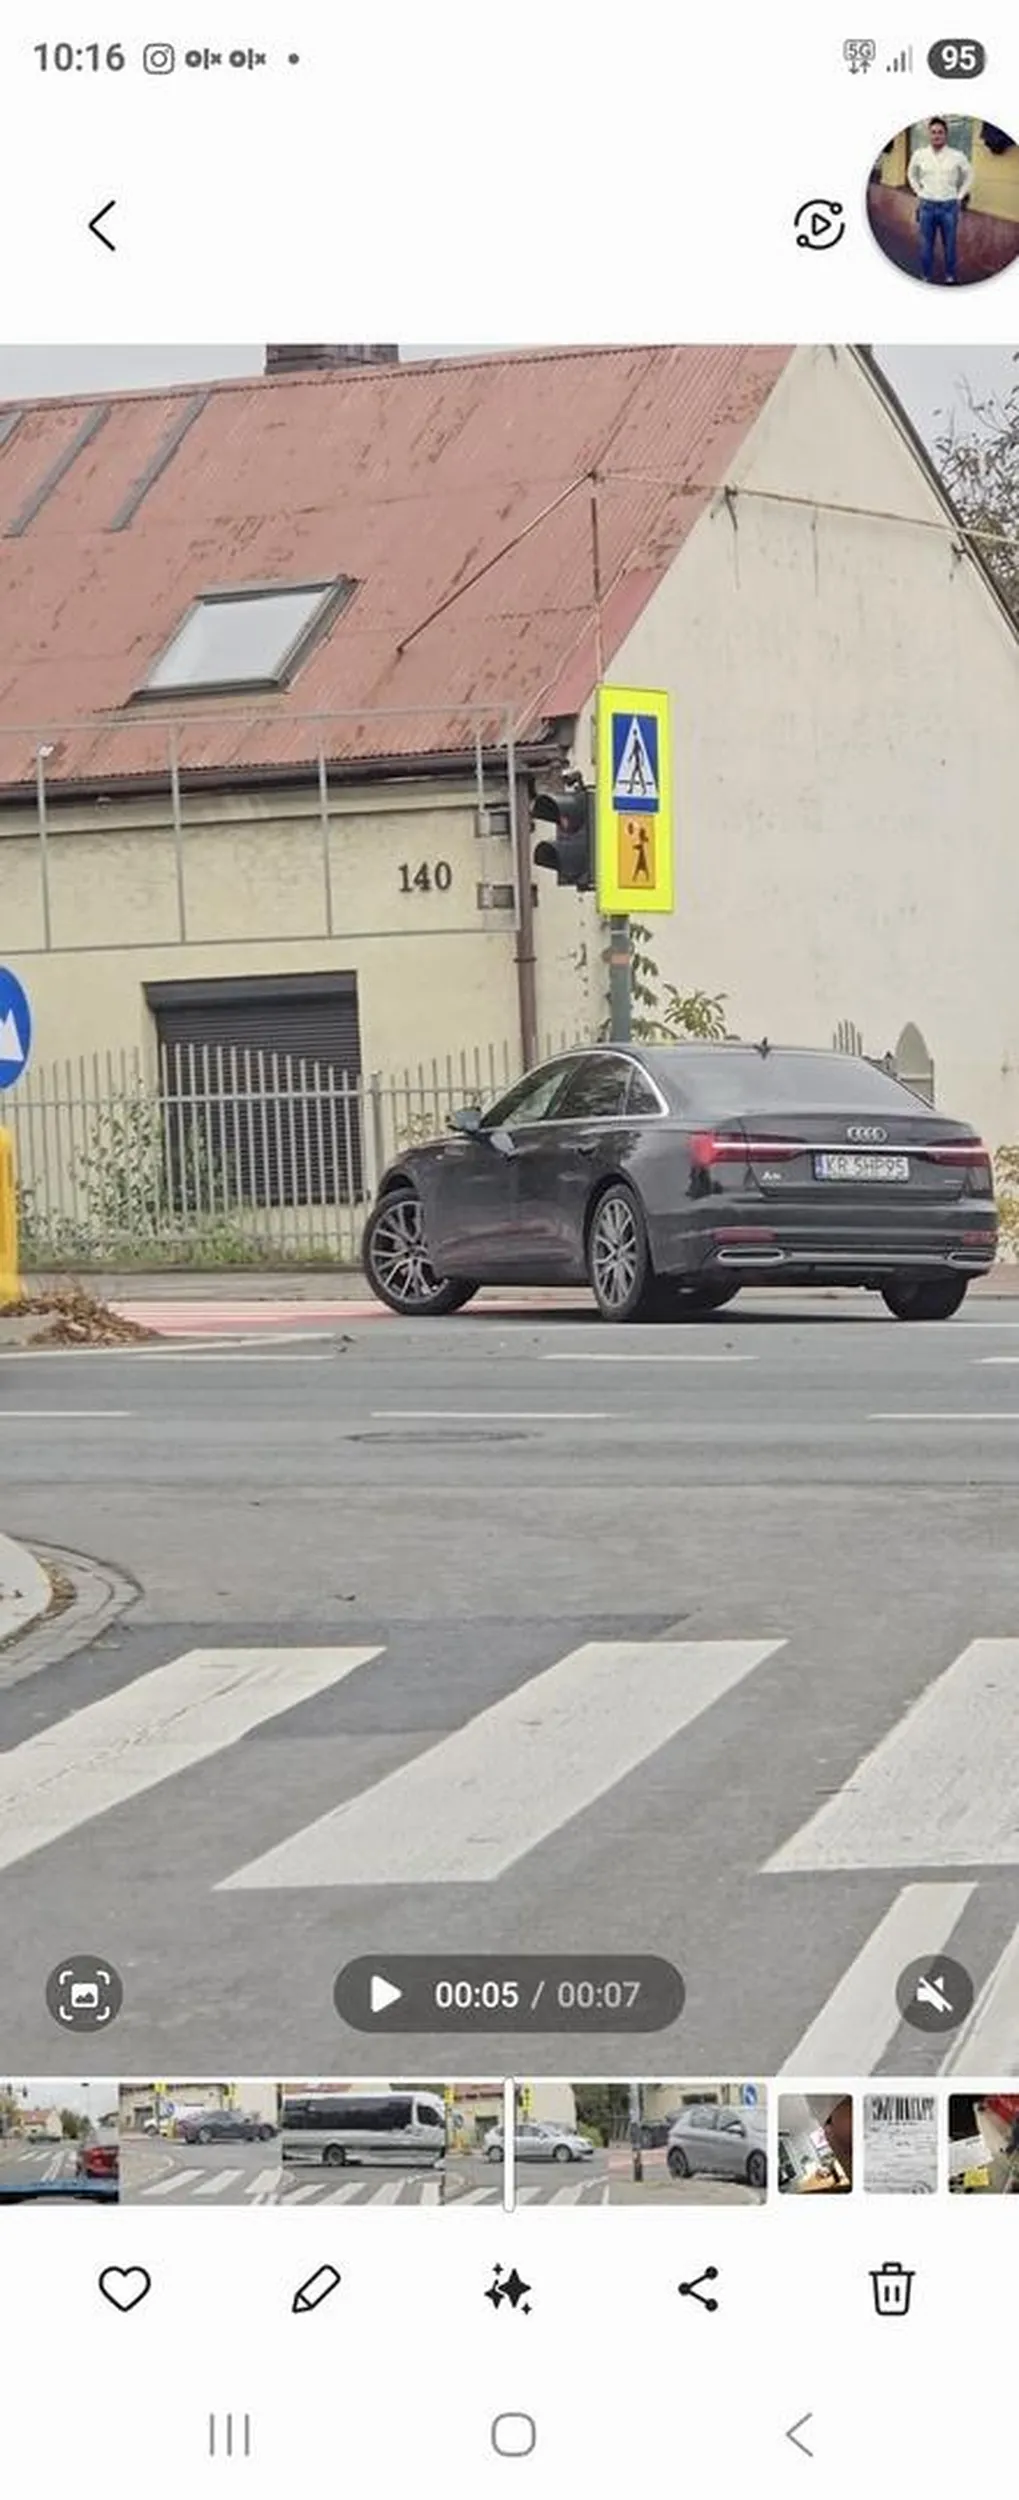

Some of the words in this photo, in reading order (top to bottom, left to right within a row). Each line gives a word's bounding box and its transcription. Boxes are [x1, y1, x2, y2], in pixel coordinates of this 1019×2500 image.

[33, 43, 125, 72] 10:16
[849, 43, 872, 59] 5G
[941, 45, 976, 71] 95
[398, 861, 452, 892] 140
[435, 1981, 519, 2009] 00:05
[531, 1981, 545, 2010] /
[557, 1981, 641, 2008] 00:07
